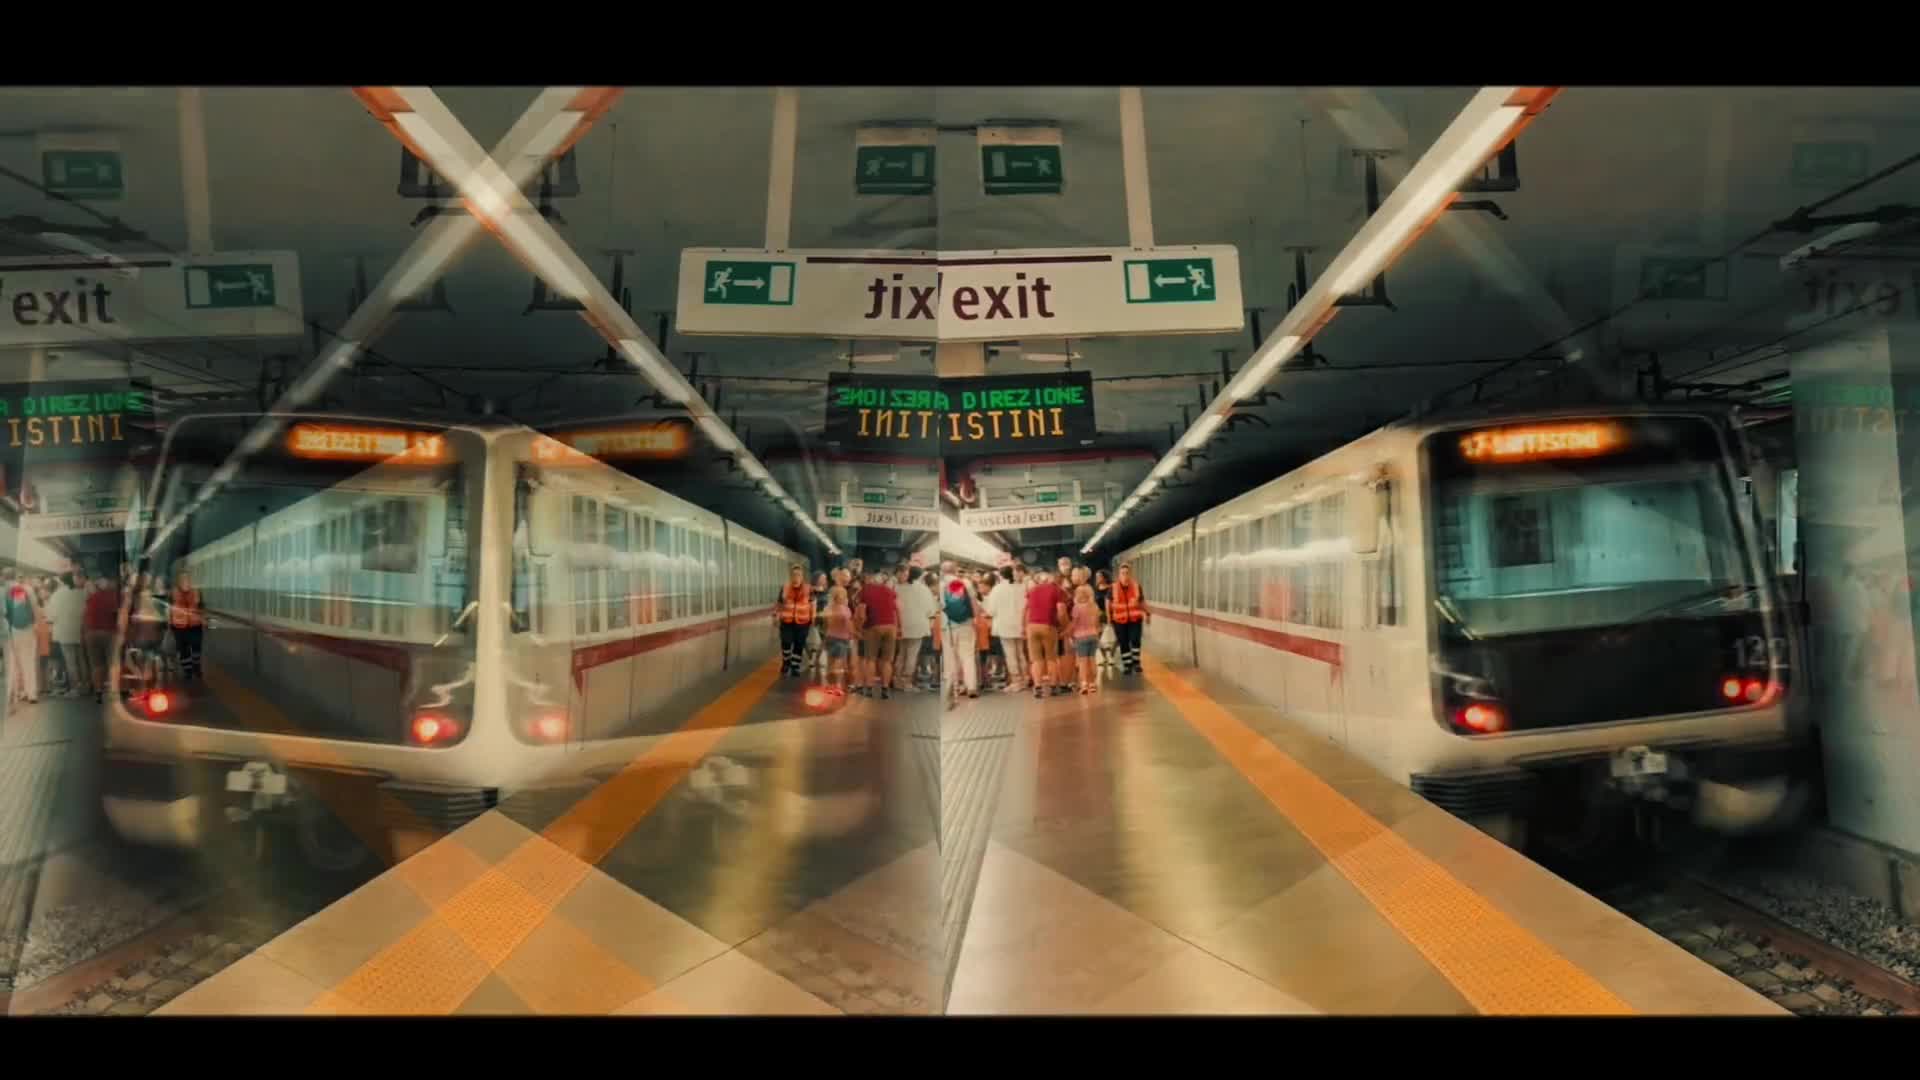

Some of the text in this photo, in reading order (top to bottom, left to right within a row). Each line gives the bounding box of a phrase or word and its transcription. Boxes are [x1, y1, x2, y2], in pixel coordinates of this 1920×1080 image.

[962, 387, 1085, 409] DIREZIONE
[8, 413, 125, 447] ISTINI
[947, 408, 1064, 441] ISTINI
